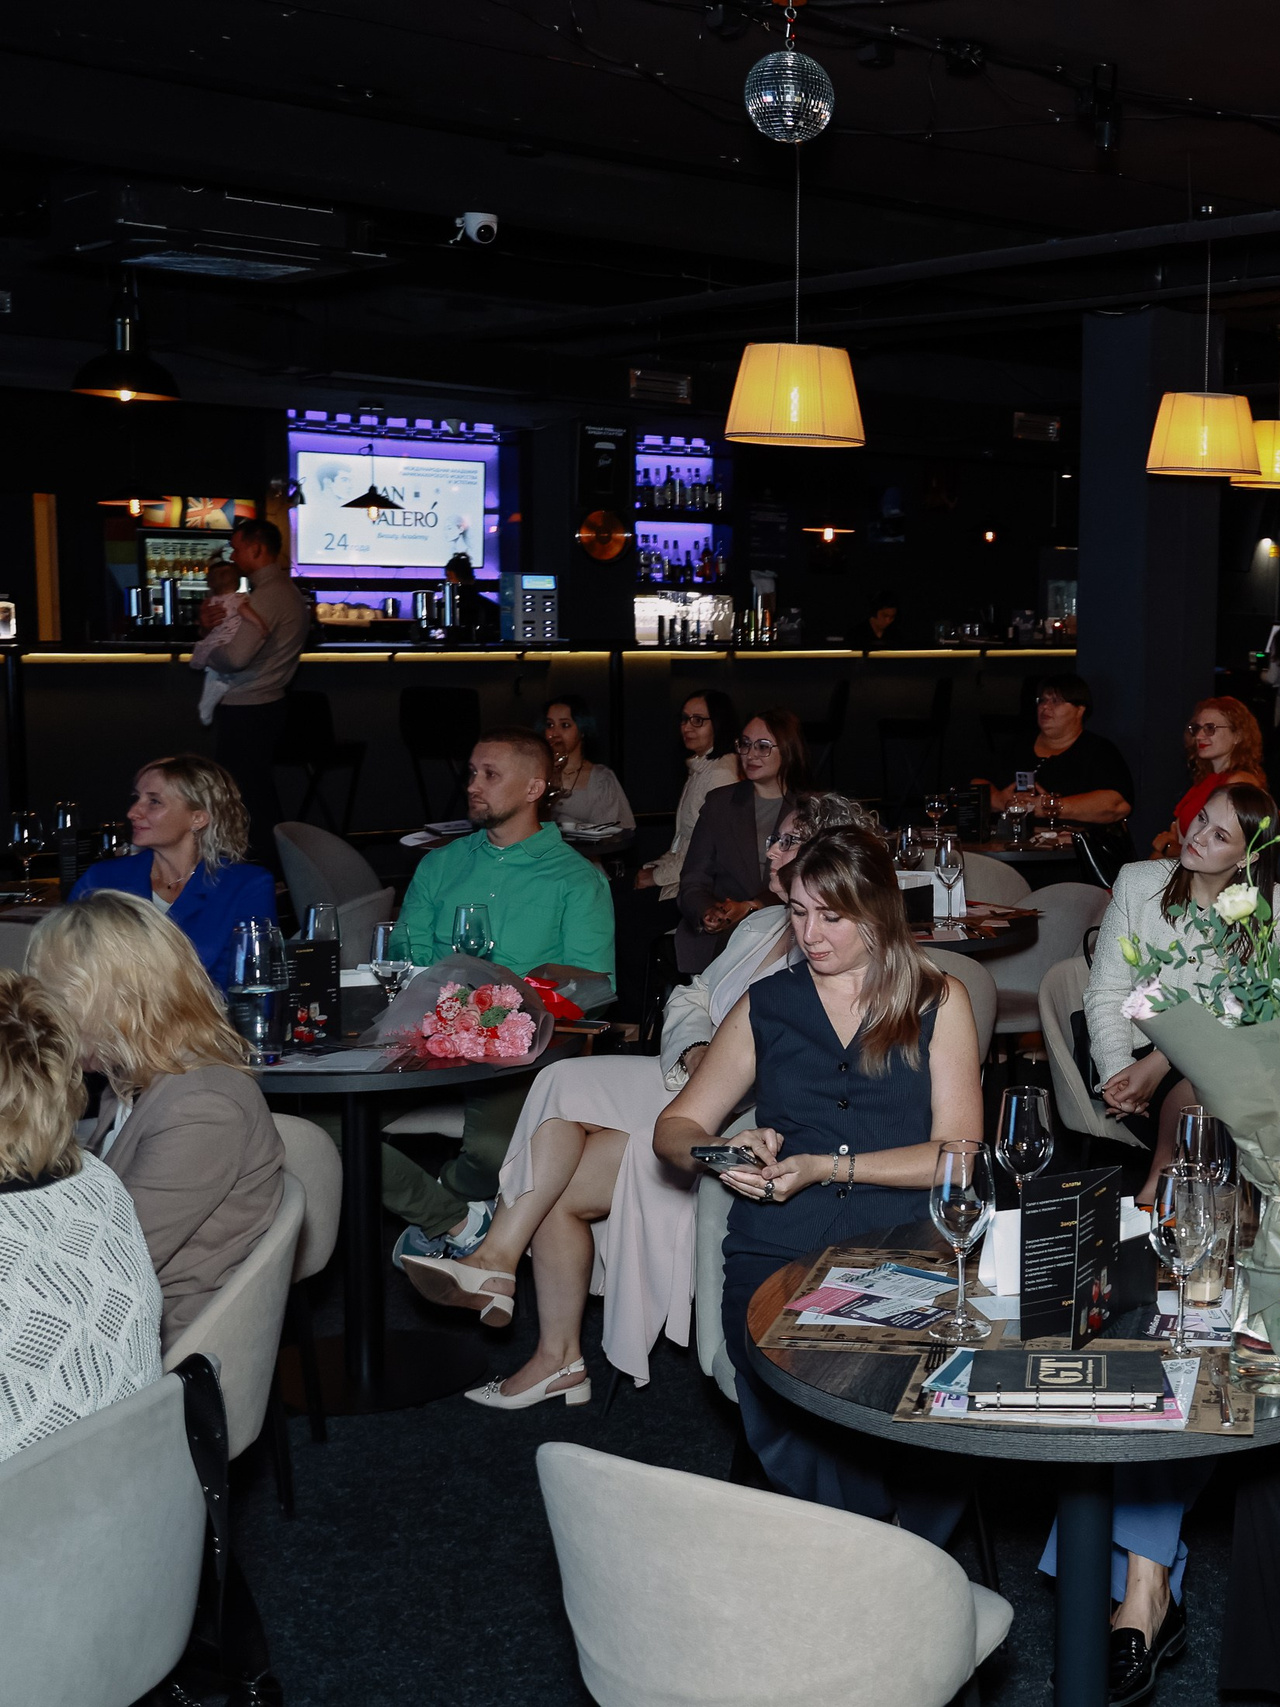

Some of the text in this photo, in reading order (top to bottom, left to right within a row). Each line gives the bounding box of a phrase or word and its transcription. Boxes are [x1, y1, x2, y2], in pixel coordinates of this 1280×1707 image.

[377, 486, 405, 502] AN
[371, 501, 439, 528] ALERÓ
[324, 533, 348, 551] 24
[1038, 1358, 1083, 1384] GT
